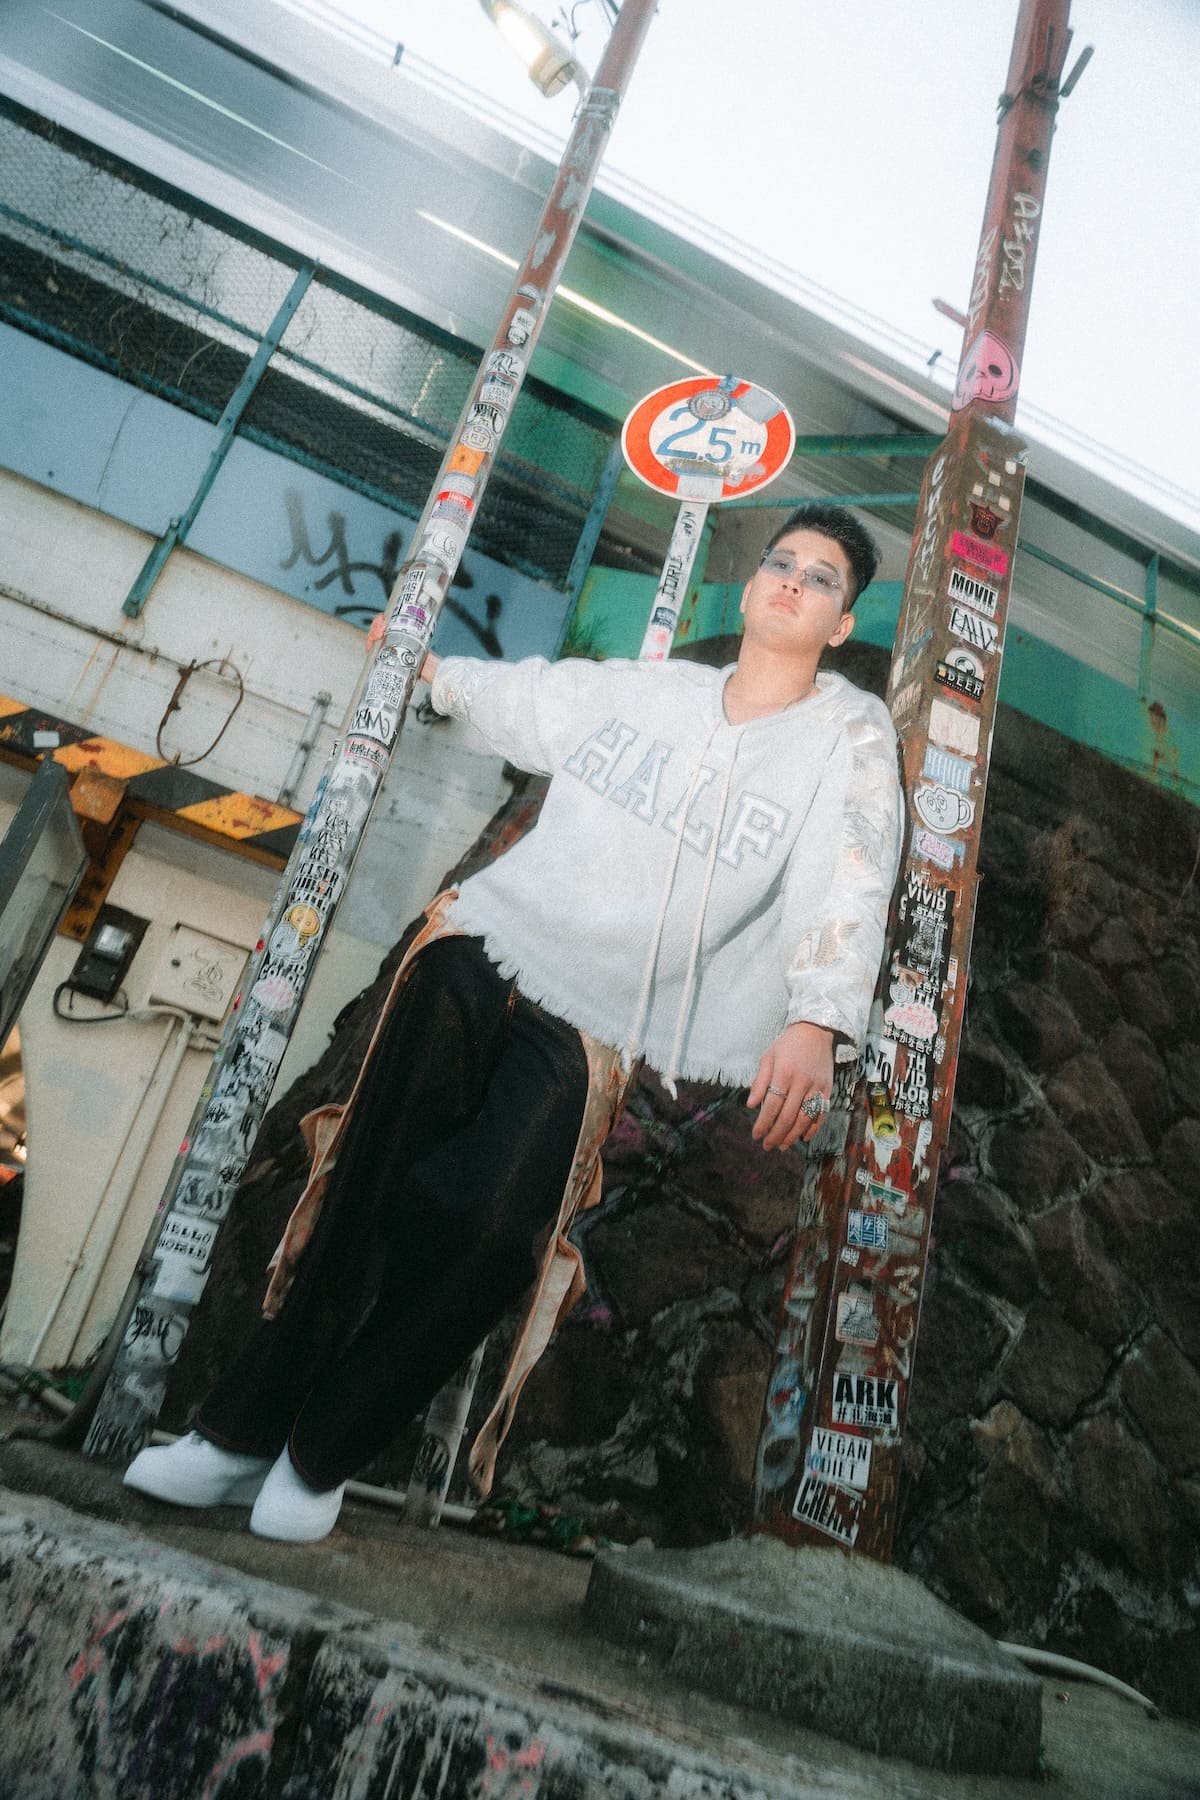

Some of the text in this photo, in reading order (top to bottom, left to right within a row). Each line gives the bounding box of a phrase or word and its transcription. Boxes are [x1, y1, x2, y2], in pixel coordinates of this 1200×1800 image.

[656, 405, 736, 464] 2.5
[951, 571, 996, 606] MOVIE
[562, 718, 793, 871] HALF
[908, 883, 947, 912] VIVID
[834, 1375, 896, 1410] ARK
[816, 1431, 868, 1461] VEGAN
